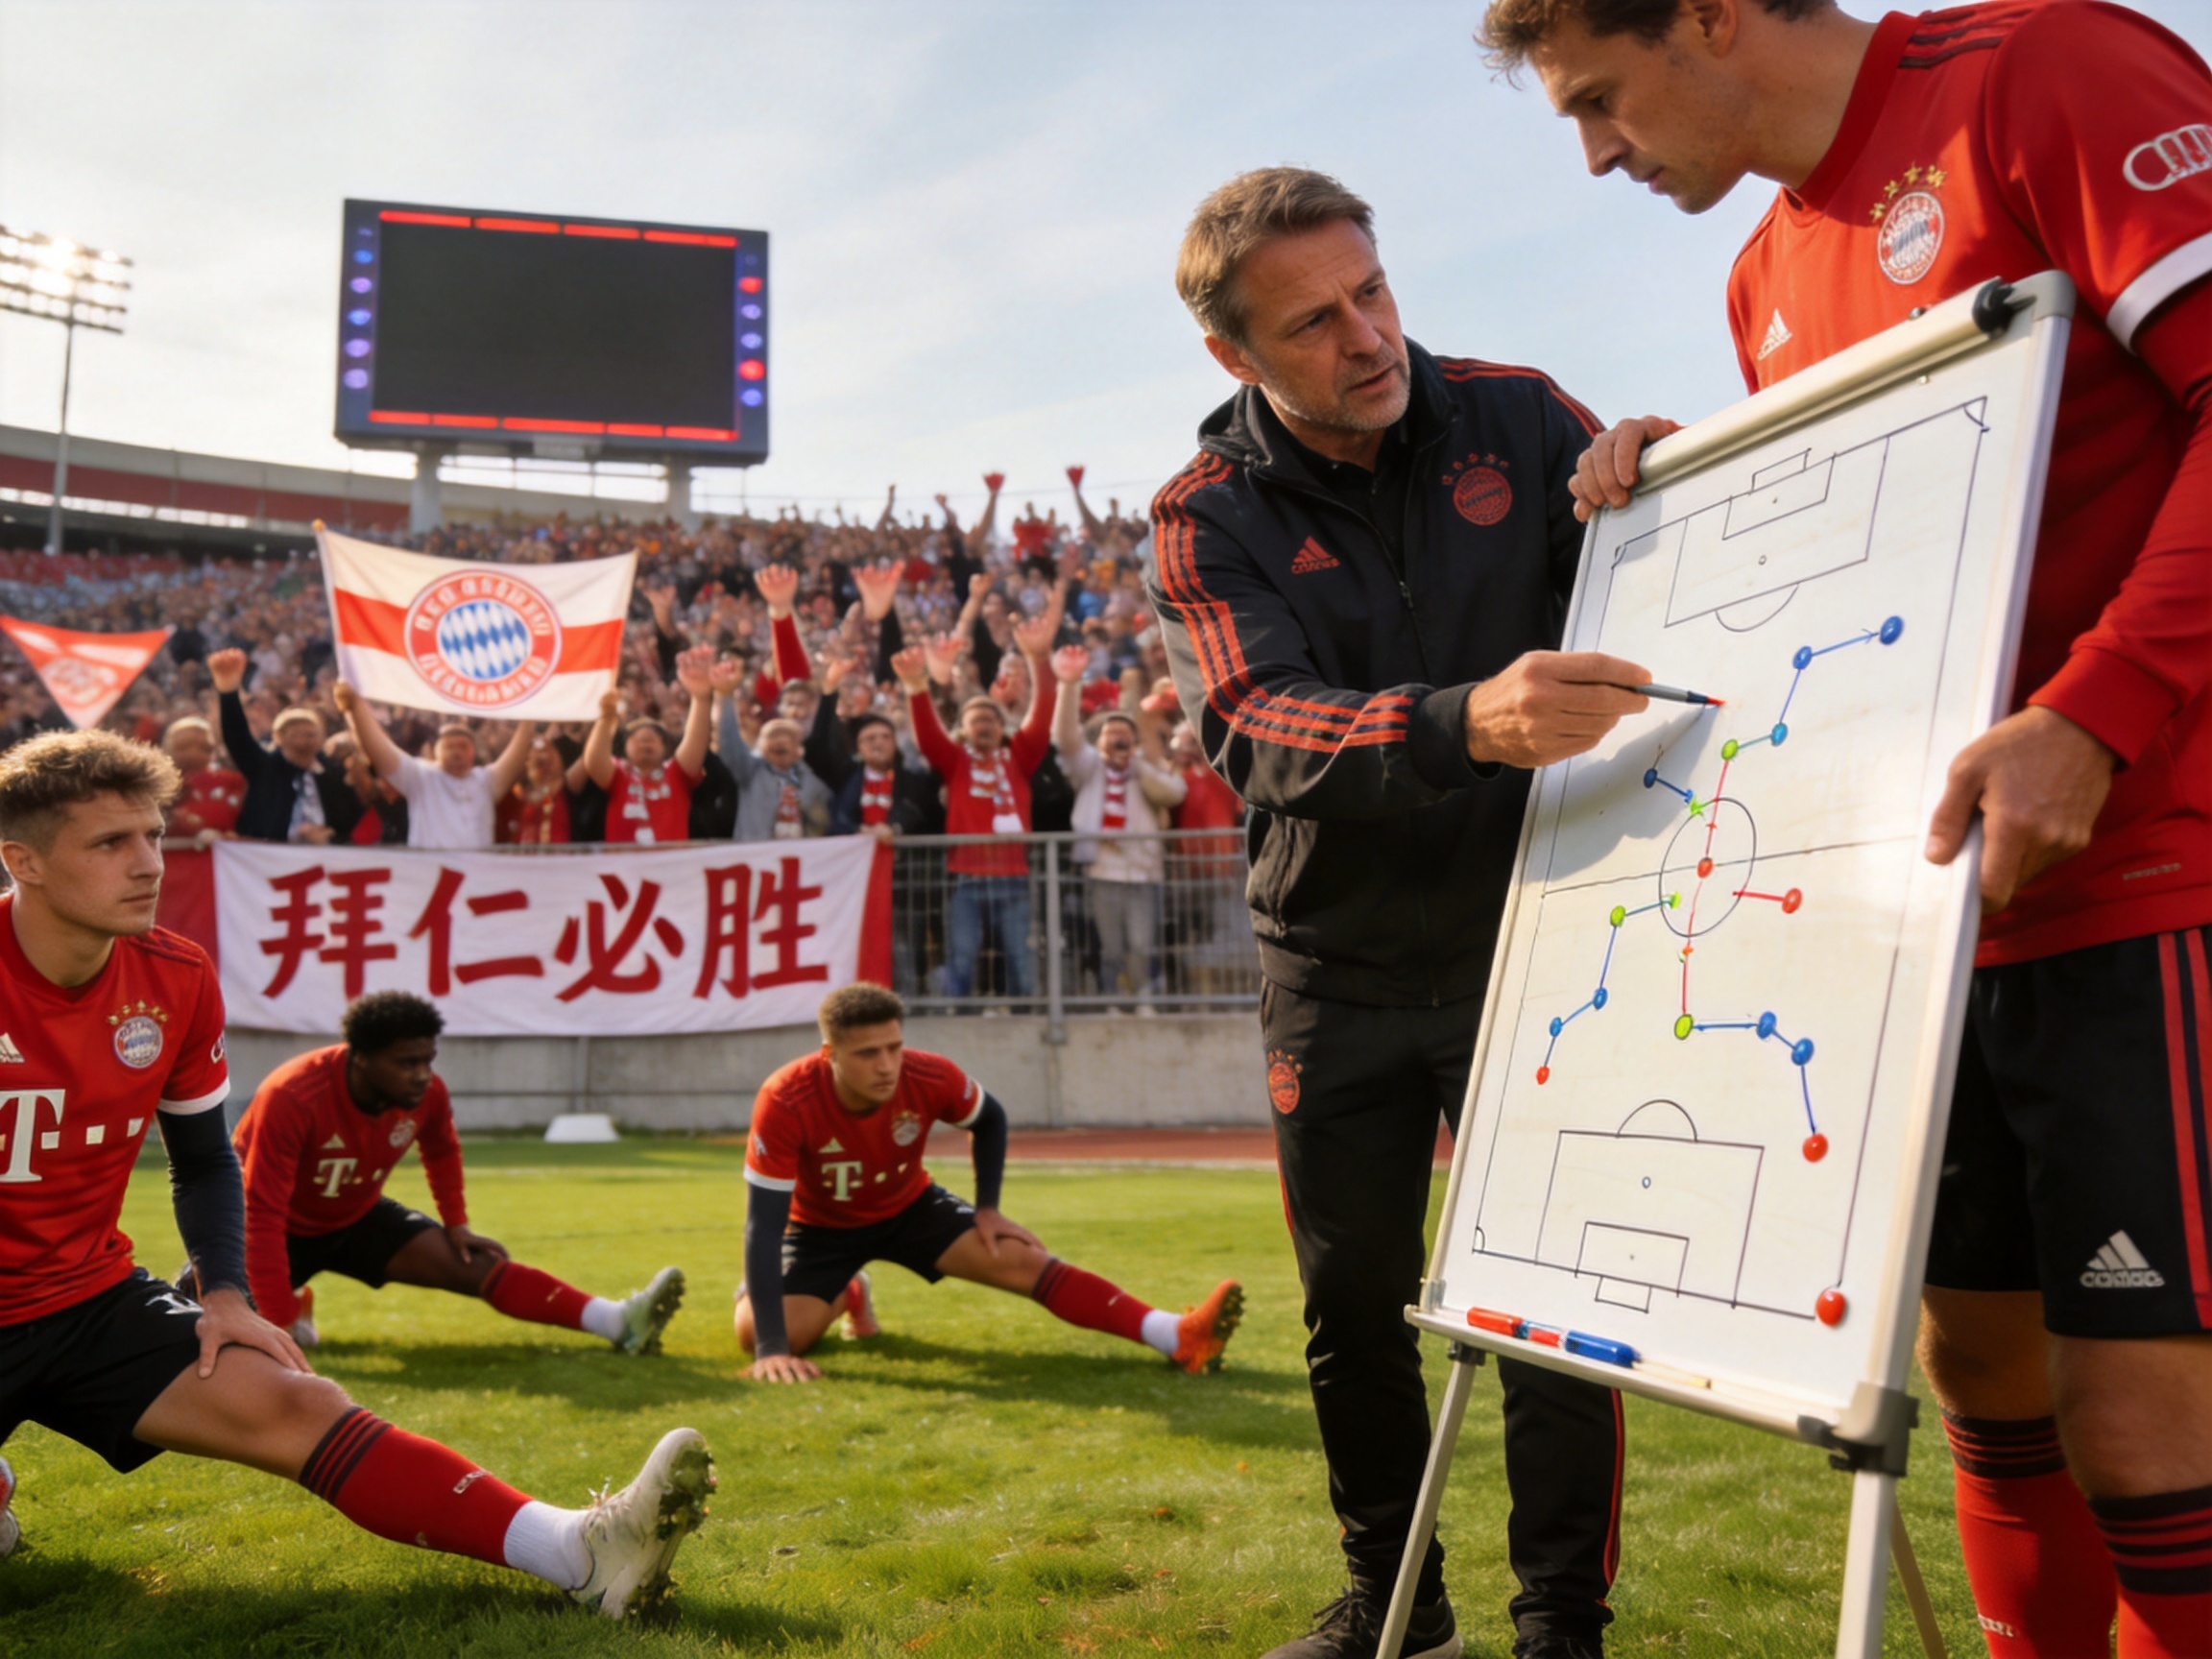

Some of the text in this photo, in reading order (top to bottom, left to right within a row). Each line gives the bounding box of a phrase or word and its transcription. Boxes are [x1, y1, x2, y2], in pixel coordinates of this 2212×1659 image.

[259, 856, 829, 1003] 拜仁必胜
[0, 1088, 66, 1183] T
[318, 1158, 358, 1198] T
[821, 1161, 862, 1201] T
